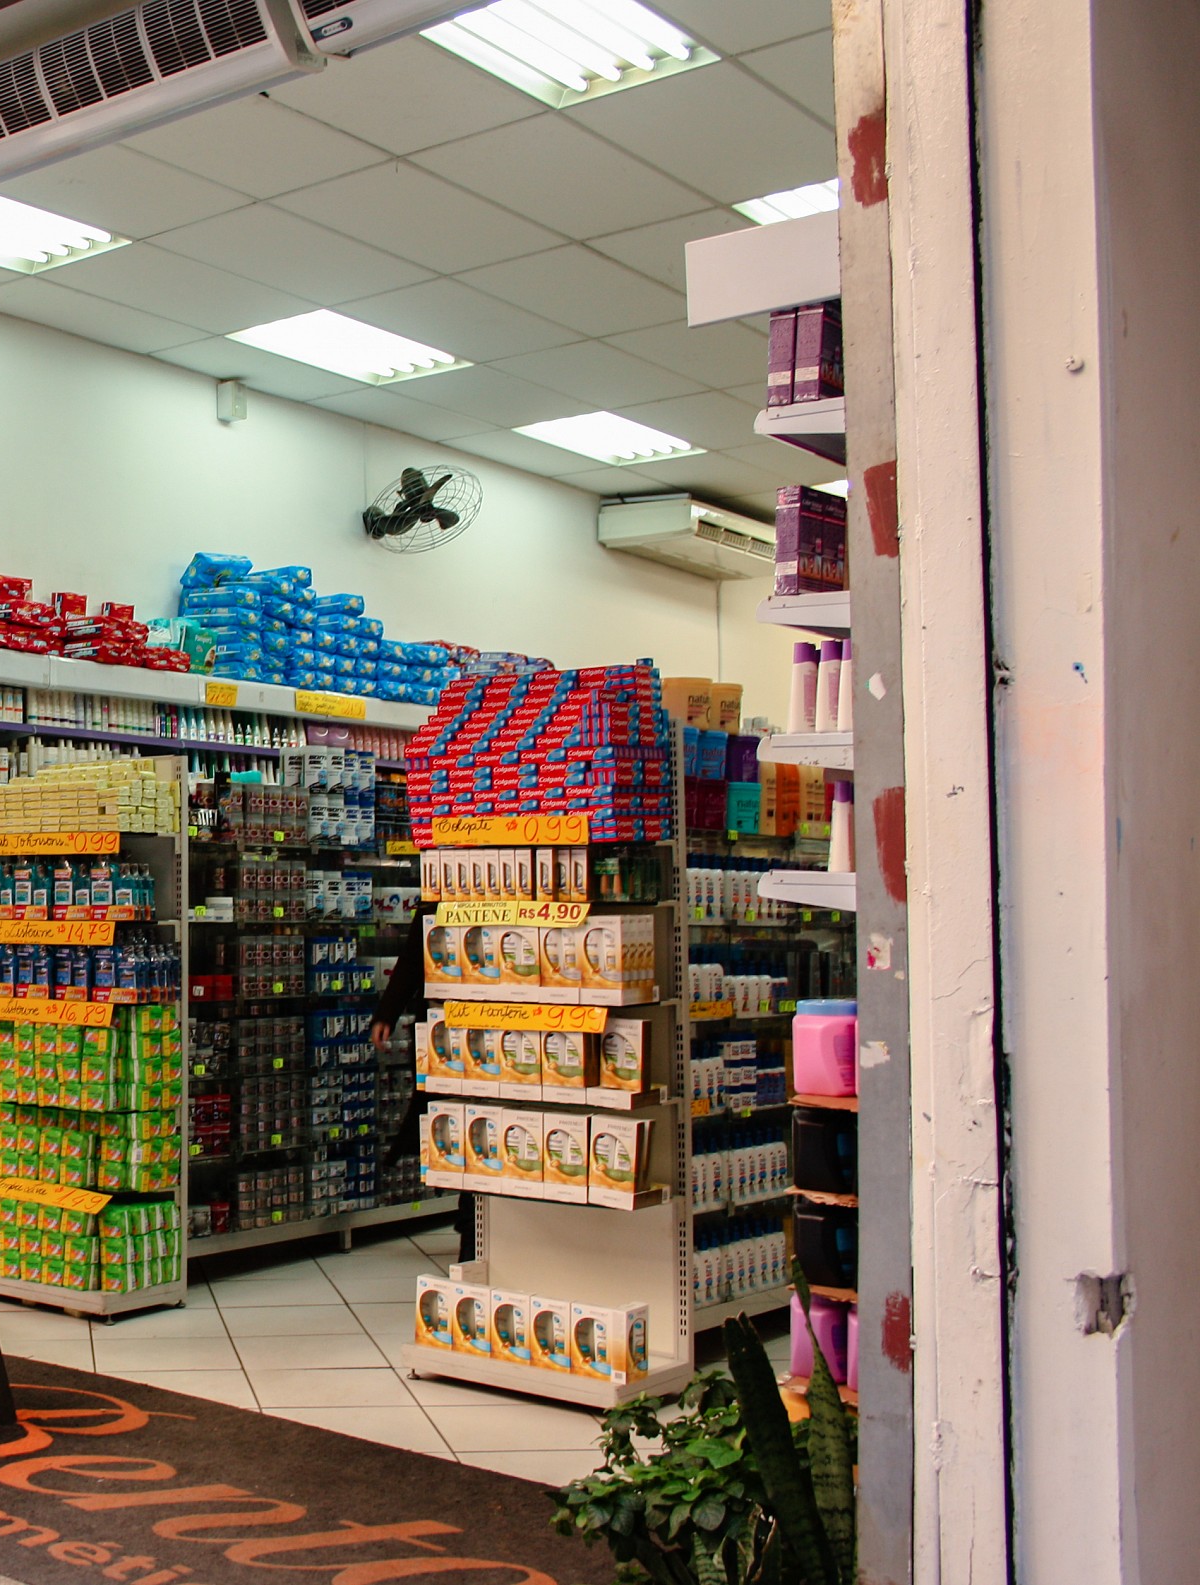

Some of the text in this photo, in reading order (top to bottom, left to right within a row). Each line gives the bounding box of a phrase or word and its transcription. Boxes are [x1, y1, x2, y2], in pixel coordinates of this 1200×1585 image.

[530, 683, 554, 691] Colgate
[525, 696, 549, 704] Colgate
[521, 752, 547, 760] Colgate
[519, 789, 545, 798] Colgate
[524, 816, 582, 843] 0,99
[74, 831, 118, 853] 0,99
[445, 909, 512, 924] PANTENE
[519, 908, 536, 919] R$
[537, 903, 582, 922] 4,90
[65, 922, 111, 943] 14,79
[59, 1003, 107, 1024] 16,89
[447, 1004, 470, 1018] Kit
[474, 1005, 530, 1022] Pantene
[544, 1006, 603, 1032] 9,99
